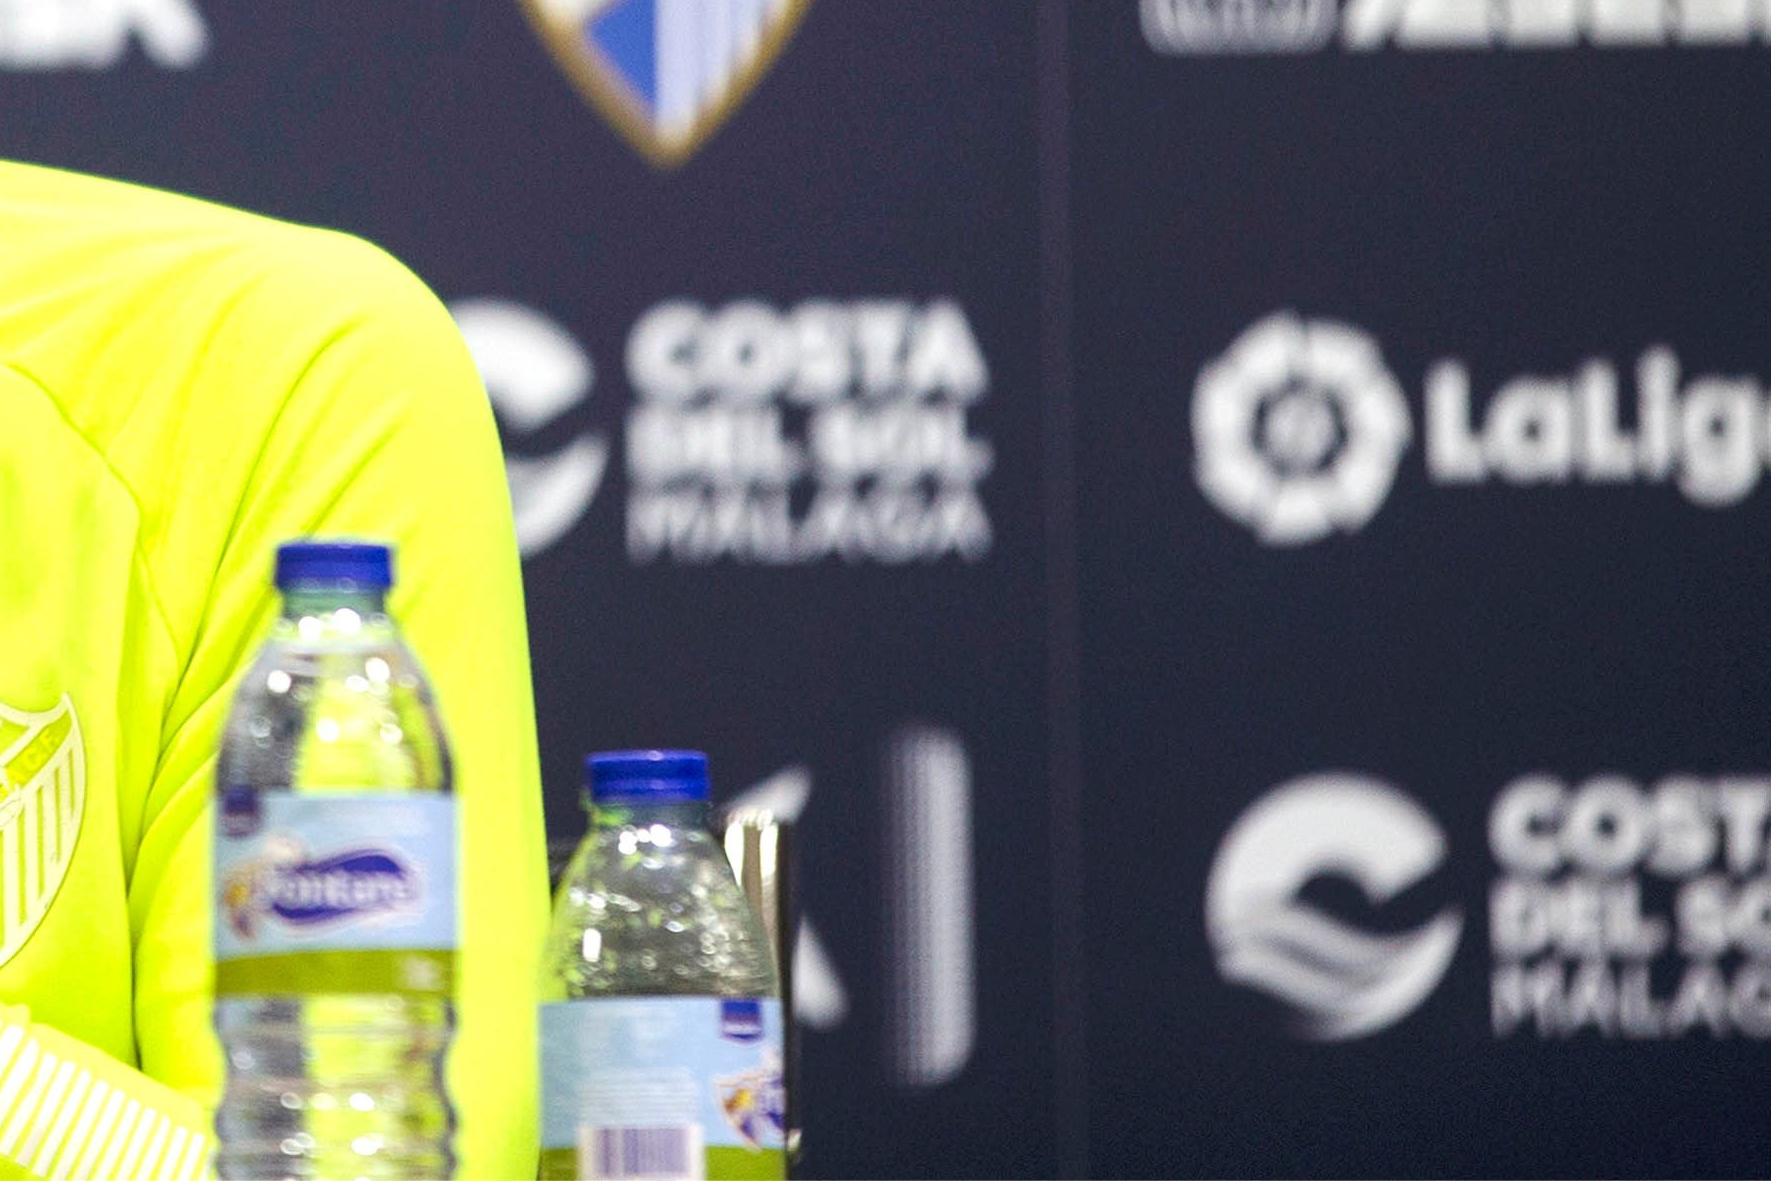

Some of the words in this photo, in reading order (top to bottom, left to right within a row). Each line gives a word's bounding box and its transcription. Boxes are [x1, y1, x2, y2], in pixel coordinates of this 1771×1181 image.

[625, 299, 988, 399] COSTA
[1423, 346, 1771, 506] LaLig
[1487, 775, 1771, 875] COST
[1676, 876, 1771, 957] SO
